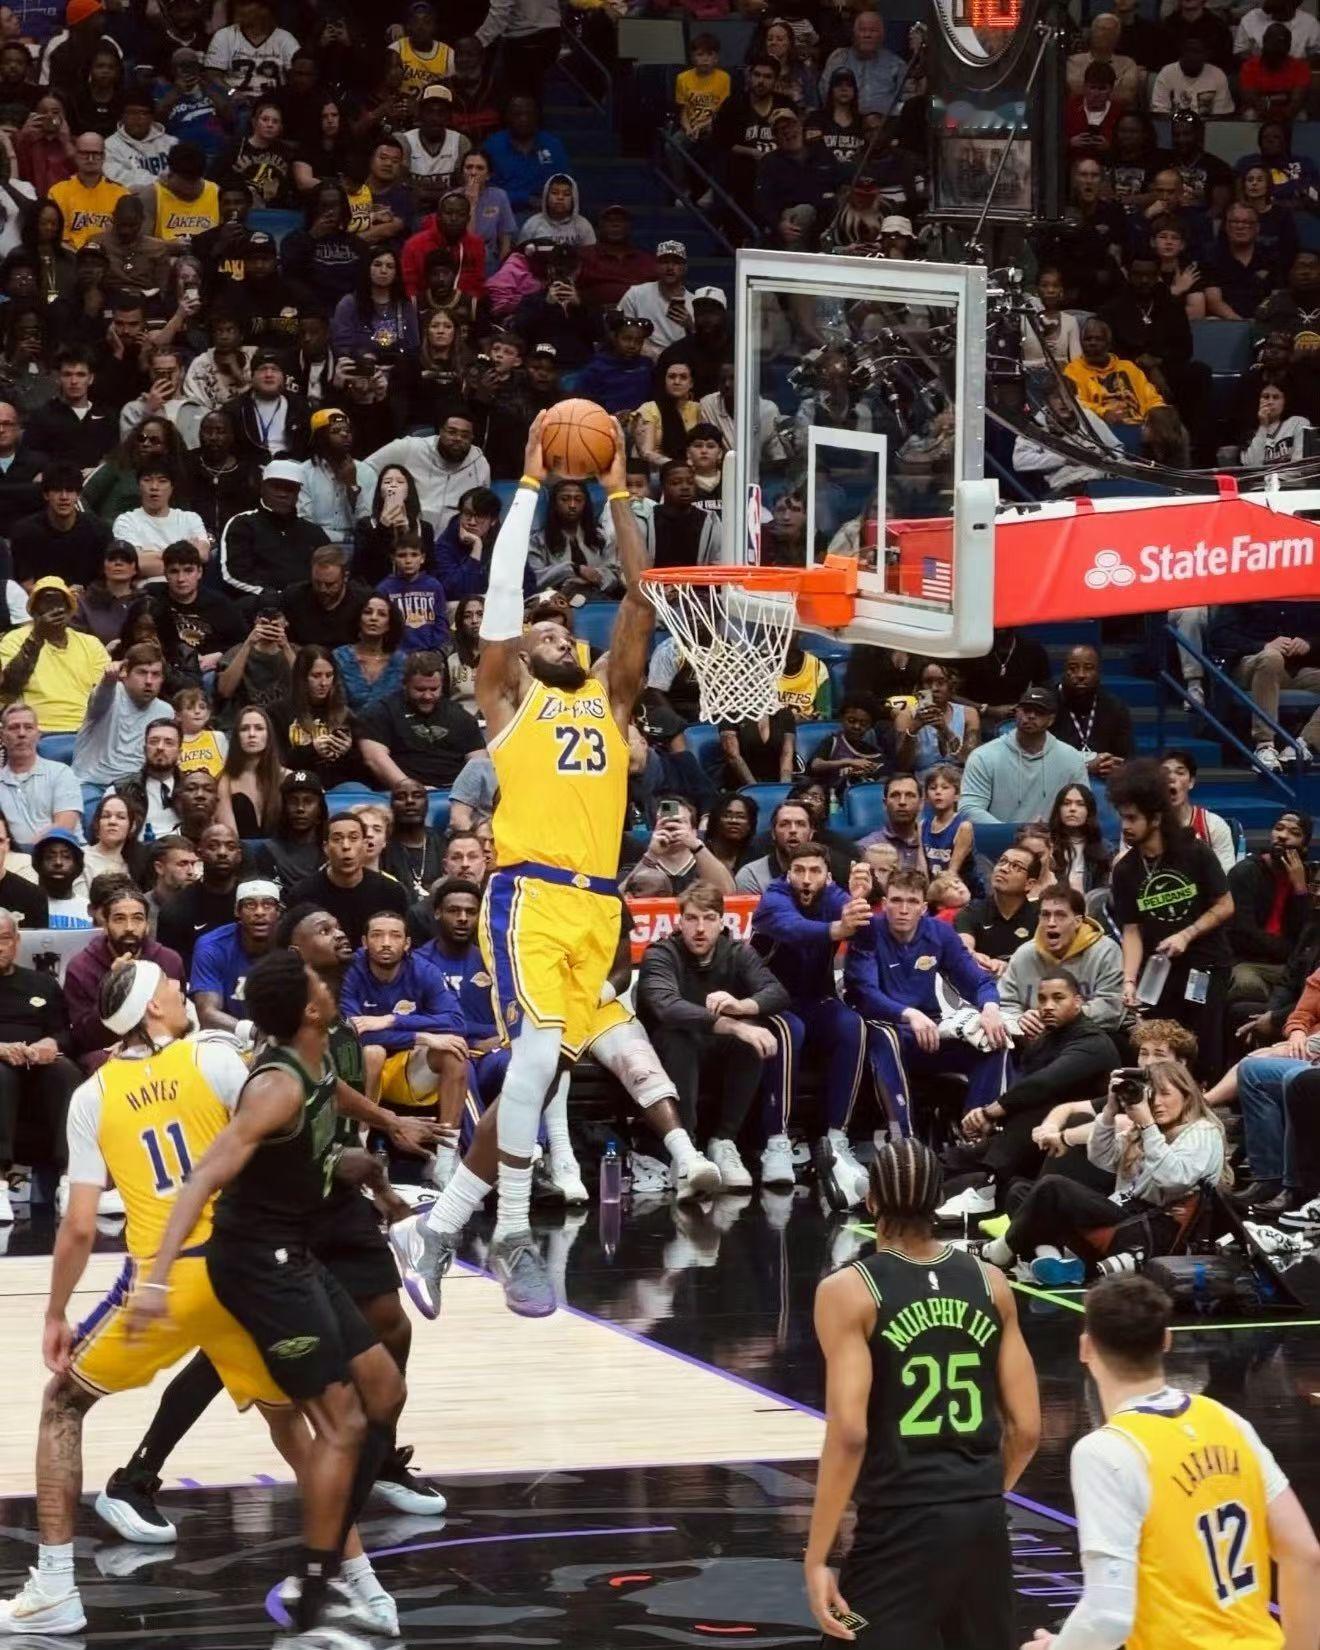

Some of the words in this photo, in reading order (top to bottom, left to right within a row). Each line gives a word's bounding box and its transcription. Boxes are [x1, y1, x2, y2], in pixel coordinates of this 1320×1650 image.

[167, 213, 212, 229] LAKERS
[1139, 540, 1227, 583] State
[1231, 534, 1314, 573] Farm
[396, 597, 436, 622] AKERS
[536, 696, 606, 721] LAKERS
[179, 748, 213, 764] AKERS
[556, 726, 607, 773] 23
[1143, 886, 1193, 909] PELICANS
[126, 1080, 179, 1113] HAYES
[140, 1122, 193, 1195] 11
[880, 1298, 969, 1353] MURPHY
[966, 1313, 999, 1349] III
[899, 1352, 985, 1437] 25
[1197, 1502, 1256, 1602] 12
